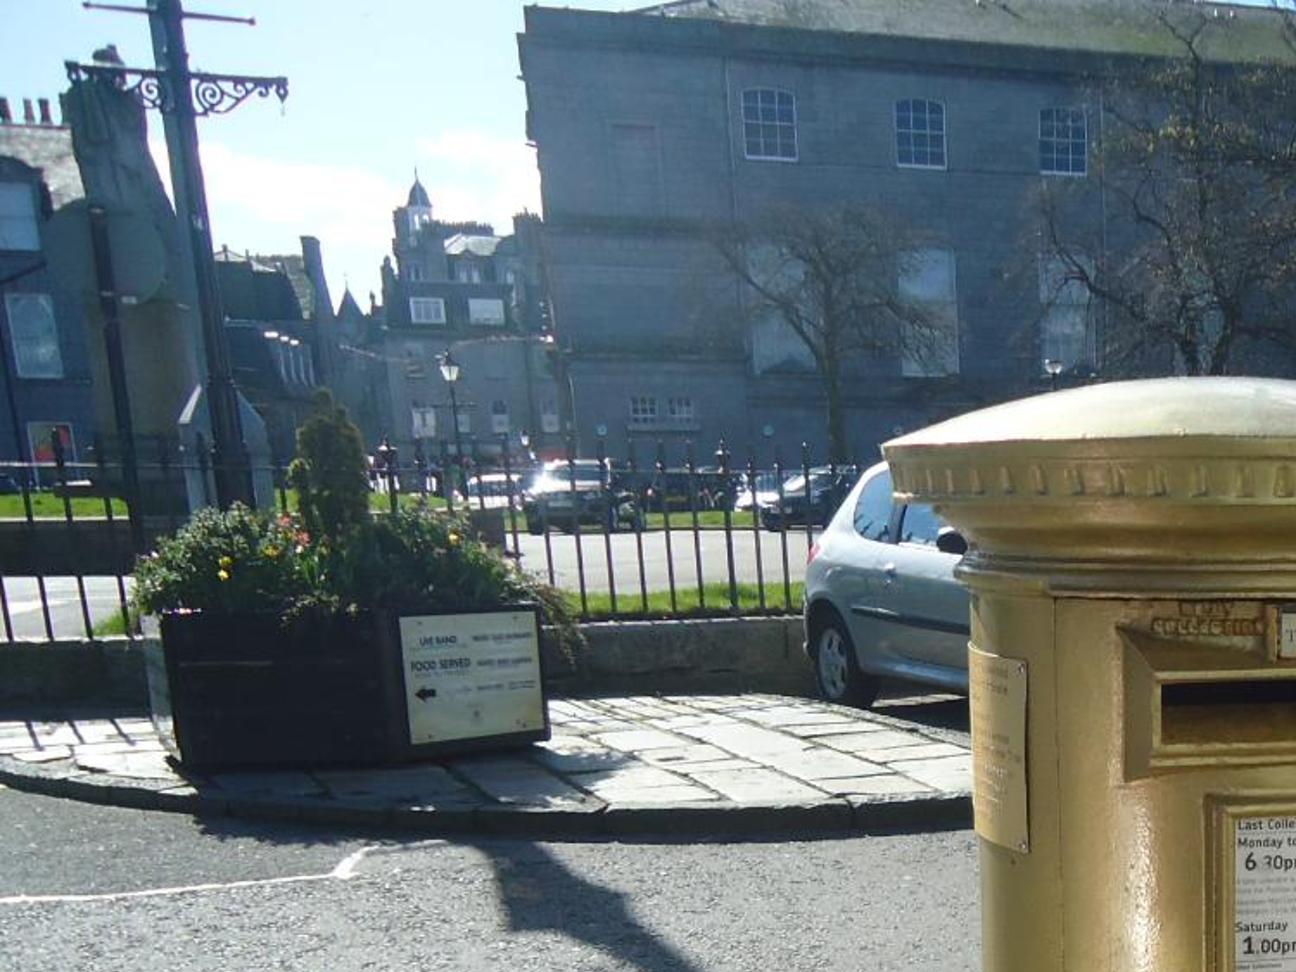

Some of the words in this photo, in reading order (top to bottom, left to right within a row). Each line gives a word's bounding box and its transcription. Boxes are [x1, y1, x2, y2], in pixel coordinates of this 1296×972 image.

[1237, 819, 1263, 831] Last
[1237, 836, 1283, 849] Monday
[1234, 920, 1288, 933] Saturday
